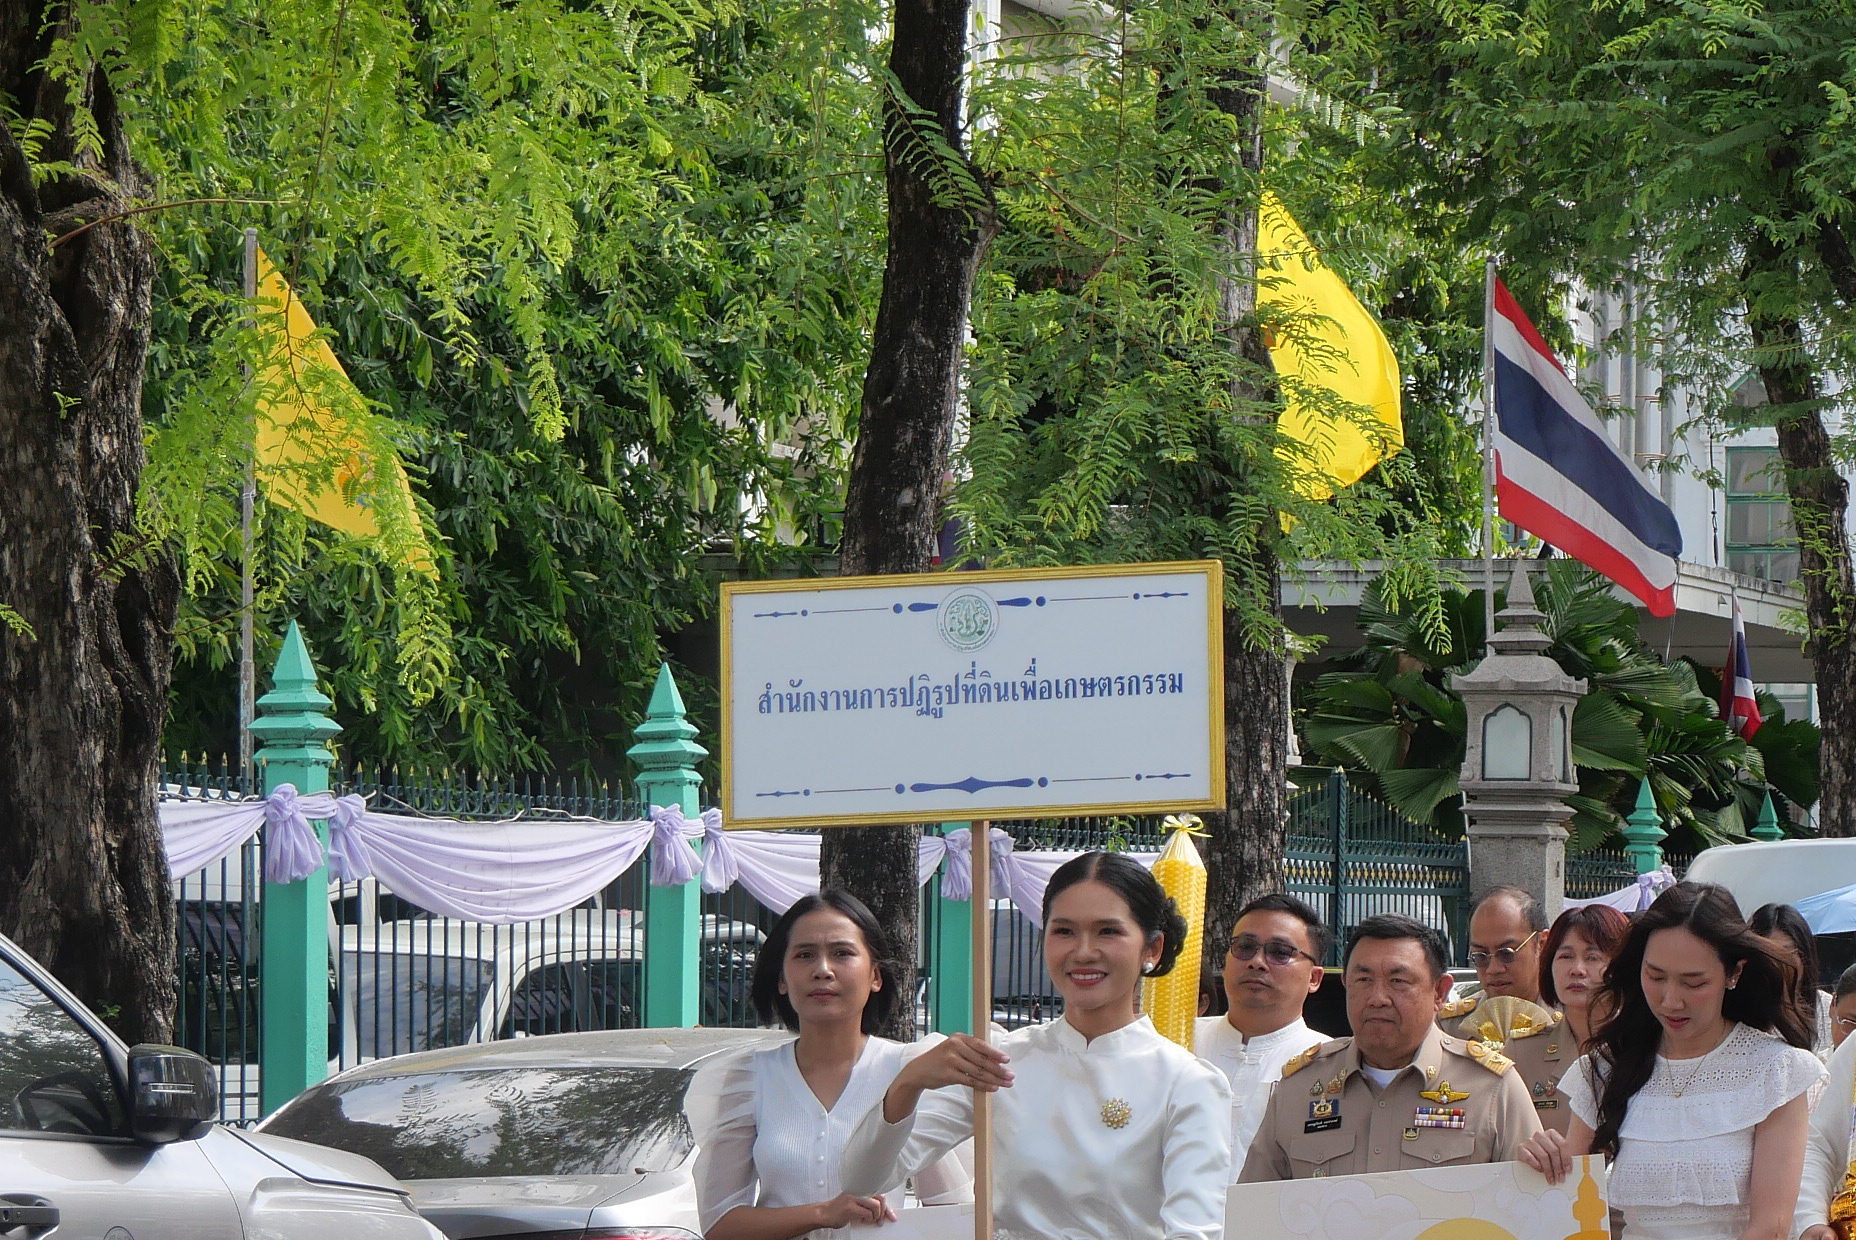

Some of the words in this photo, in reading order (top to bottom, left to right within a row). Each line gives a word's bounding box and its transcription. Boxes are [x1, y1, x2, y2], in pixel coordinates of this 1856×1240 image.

[758, 658, 1184, 719] สำนักงานการปฏิรูปที่ดินเพื่อเกษตรกรรม
